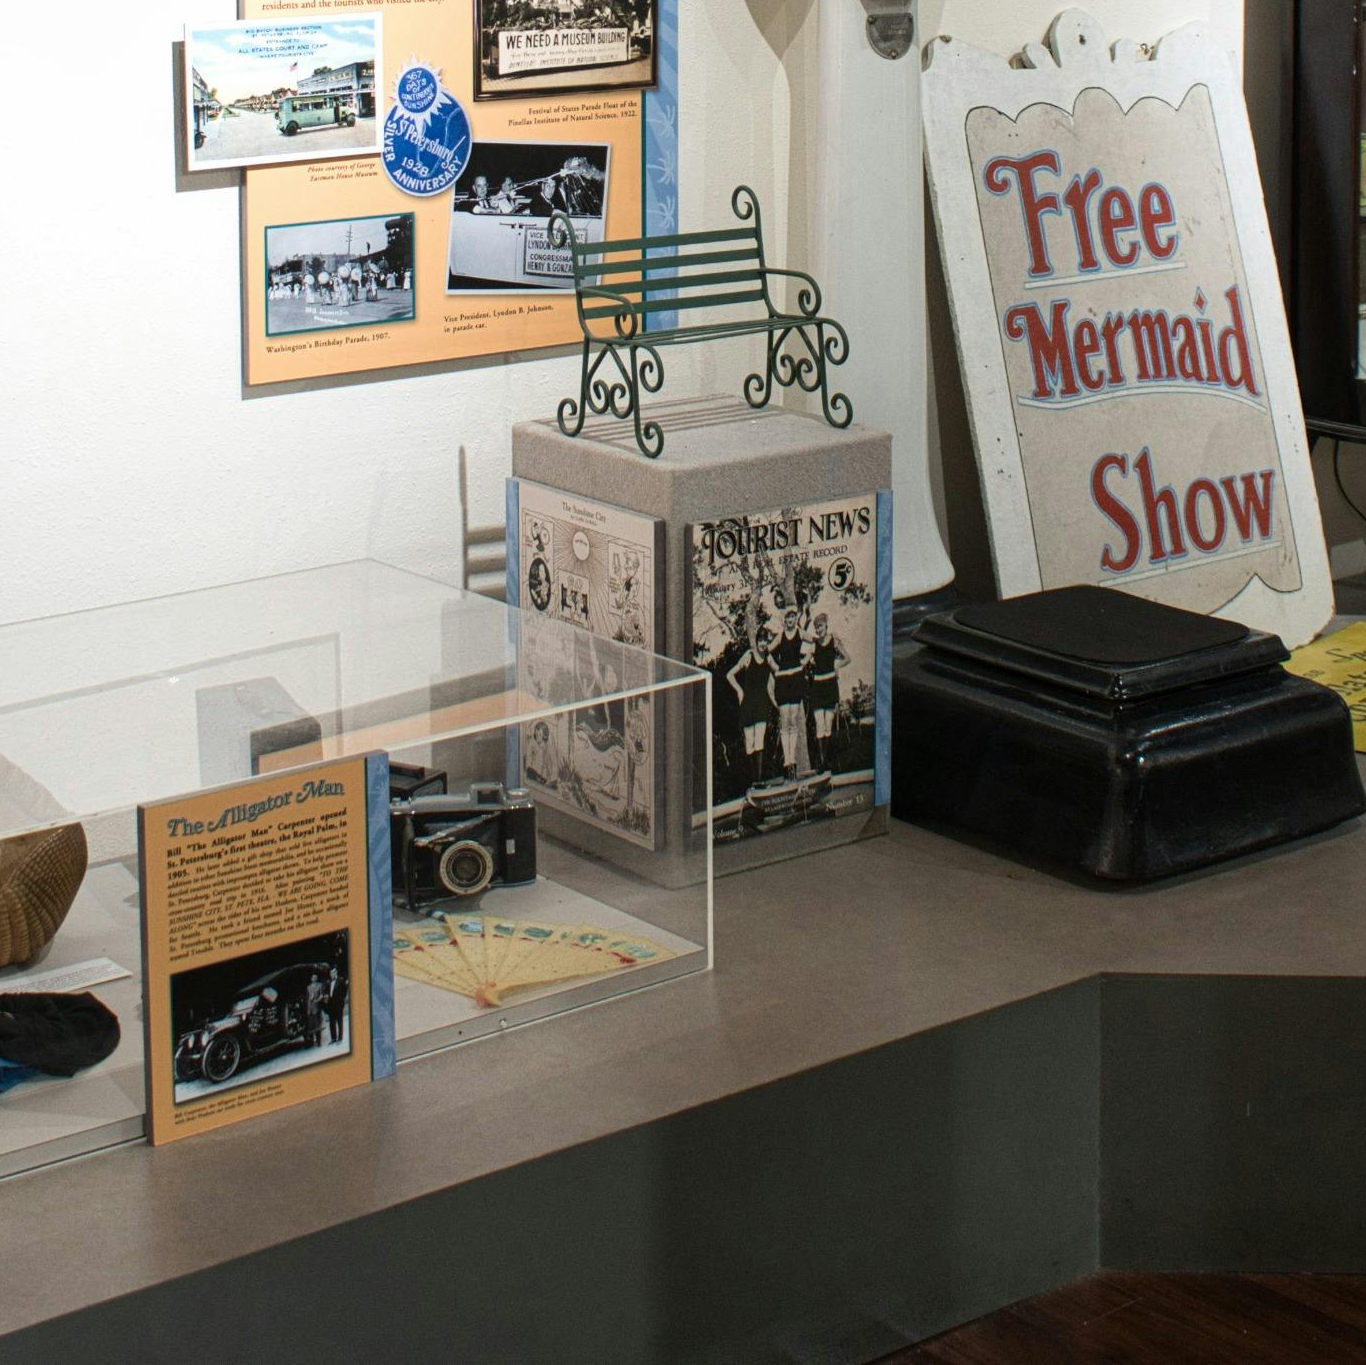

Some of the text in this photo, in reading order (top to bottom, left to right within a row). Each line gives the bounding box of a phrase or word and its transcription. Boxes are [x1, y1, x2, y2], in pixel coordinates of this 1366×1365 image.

[504, 31, 626, 49] WE NEED A MUSEUM BUILDING
[384, 119, 396, 163] SILVER
[401, 156, 430, 176] 1928
[392, 155, 463, 192] ANNIVERSARY
[983, 147, 1180, 279] Free
[1003, 283, 1262, 402] Mermaid
[1088, 444, 1277, 575] Show
[701, 506, 871, 567] TOURIST NEWS
[813, 544, 848, 559] RECORD
[166, 779, 346, 837] The Alligator Man
[166, 807, 347, 858] Bill "The Alligator Man" Carpenter opened
[167, 819, 347, 870] St. Petersburg's first theatre, the Royal Palm, in
[167, 869, 190, 881] 1905.
